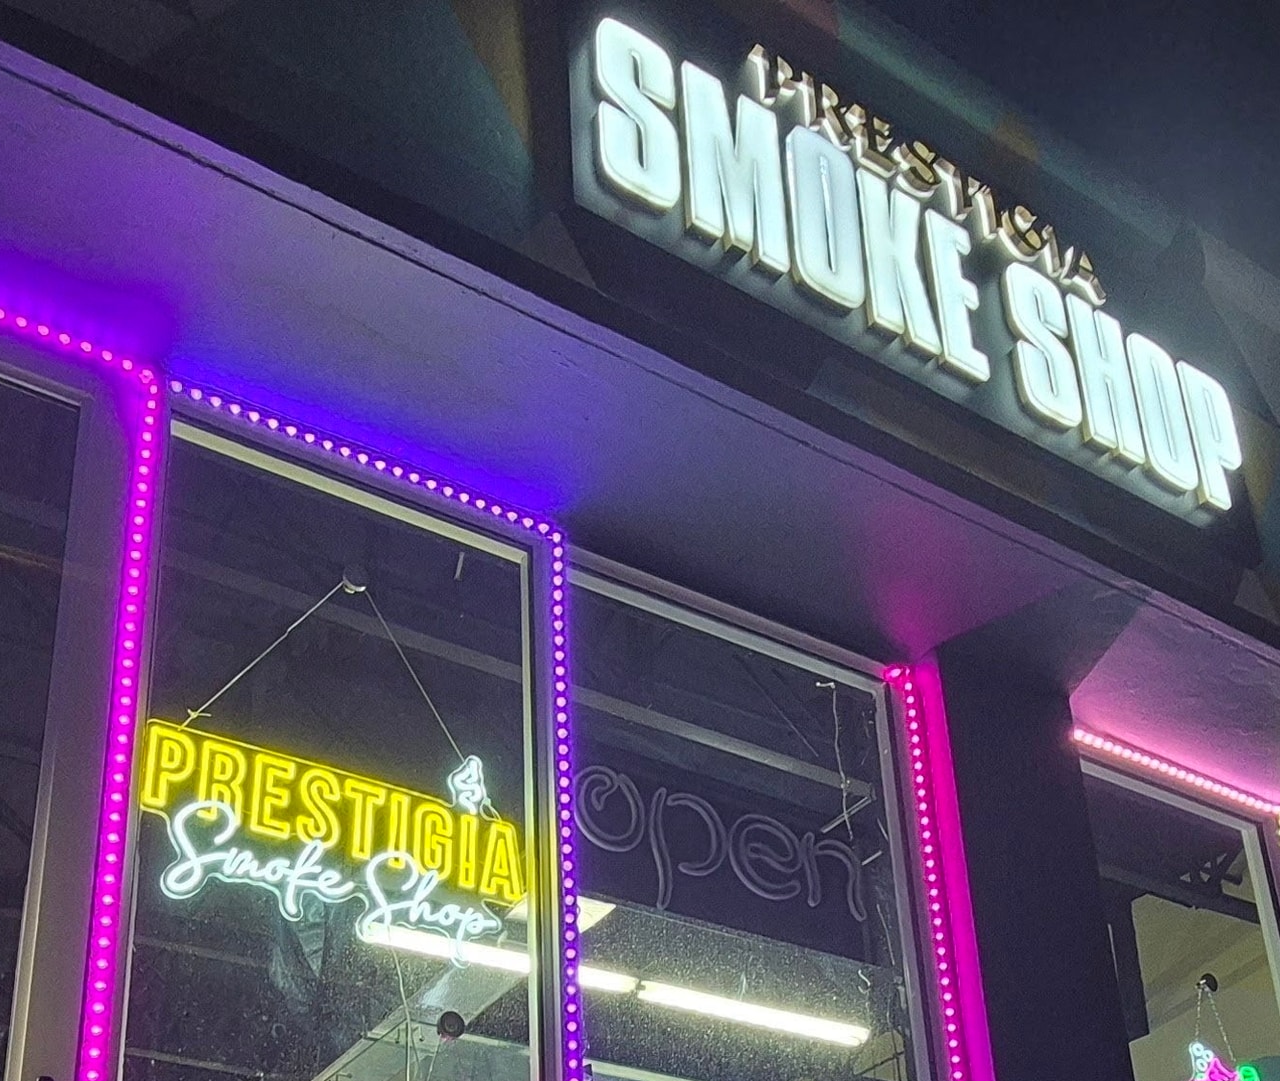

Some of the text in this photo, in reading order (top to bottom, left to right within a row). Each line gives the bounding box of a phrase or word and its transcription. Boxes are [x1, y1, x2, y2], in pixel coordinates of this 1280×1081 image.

[595, 16, 1244, 513] SMOKE SHOP
[142, 725, 525, 902] PRESTIGIA
[164, 800, 500, 965] Smoke Shop
[574, 765, 868, 922] open
